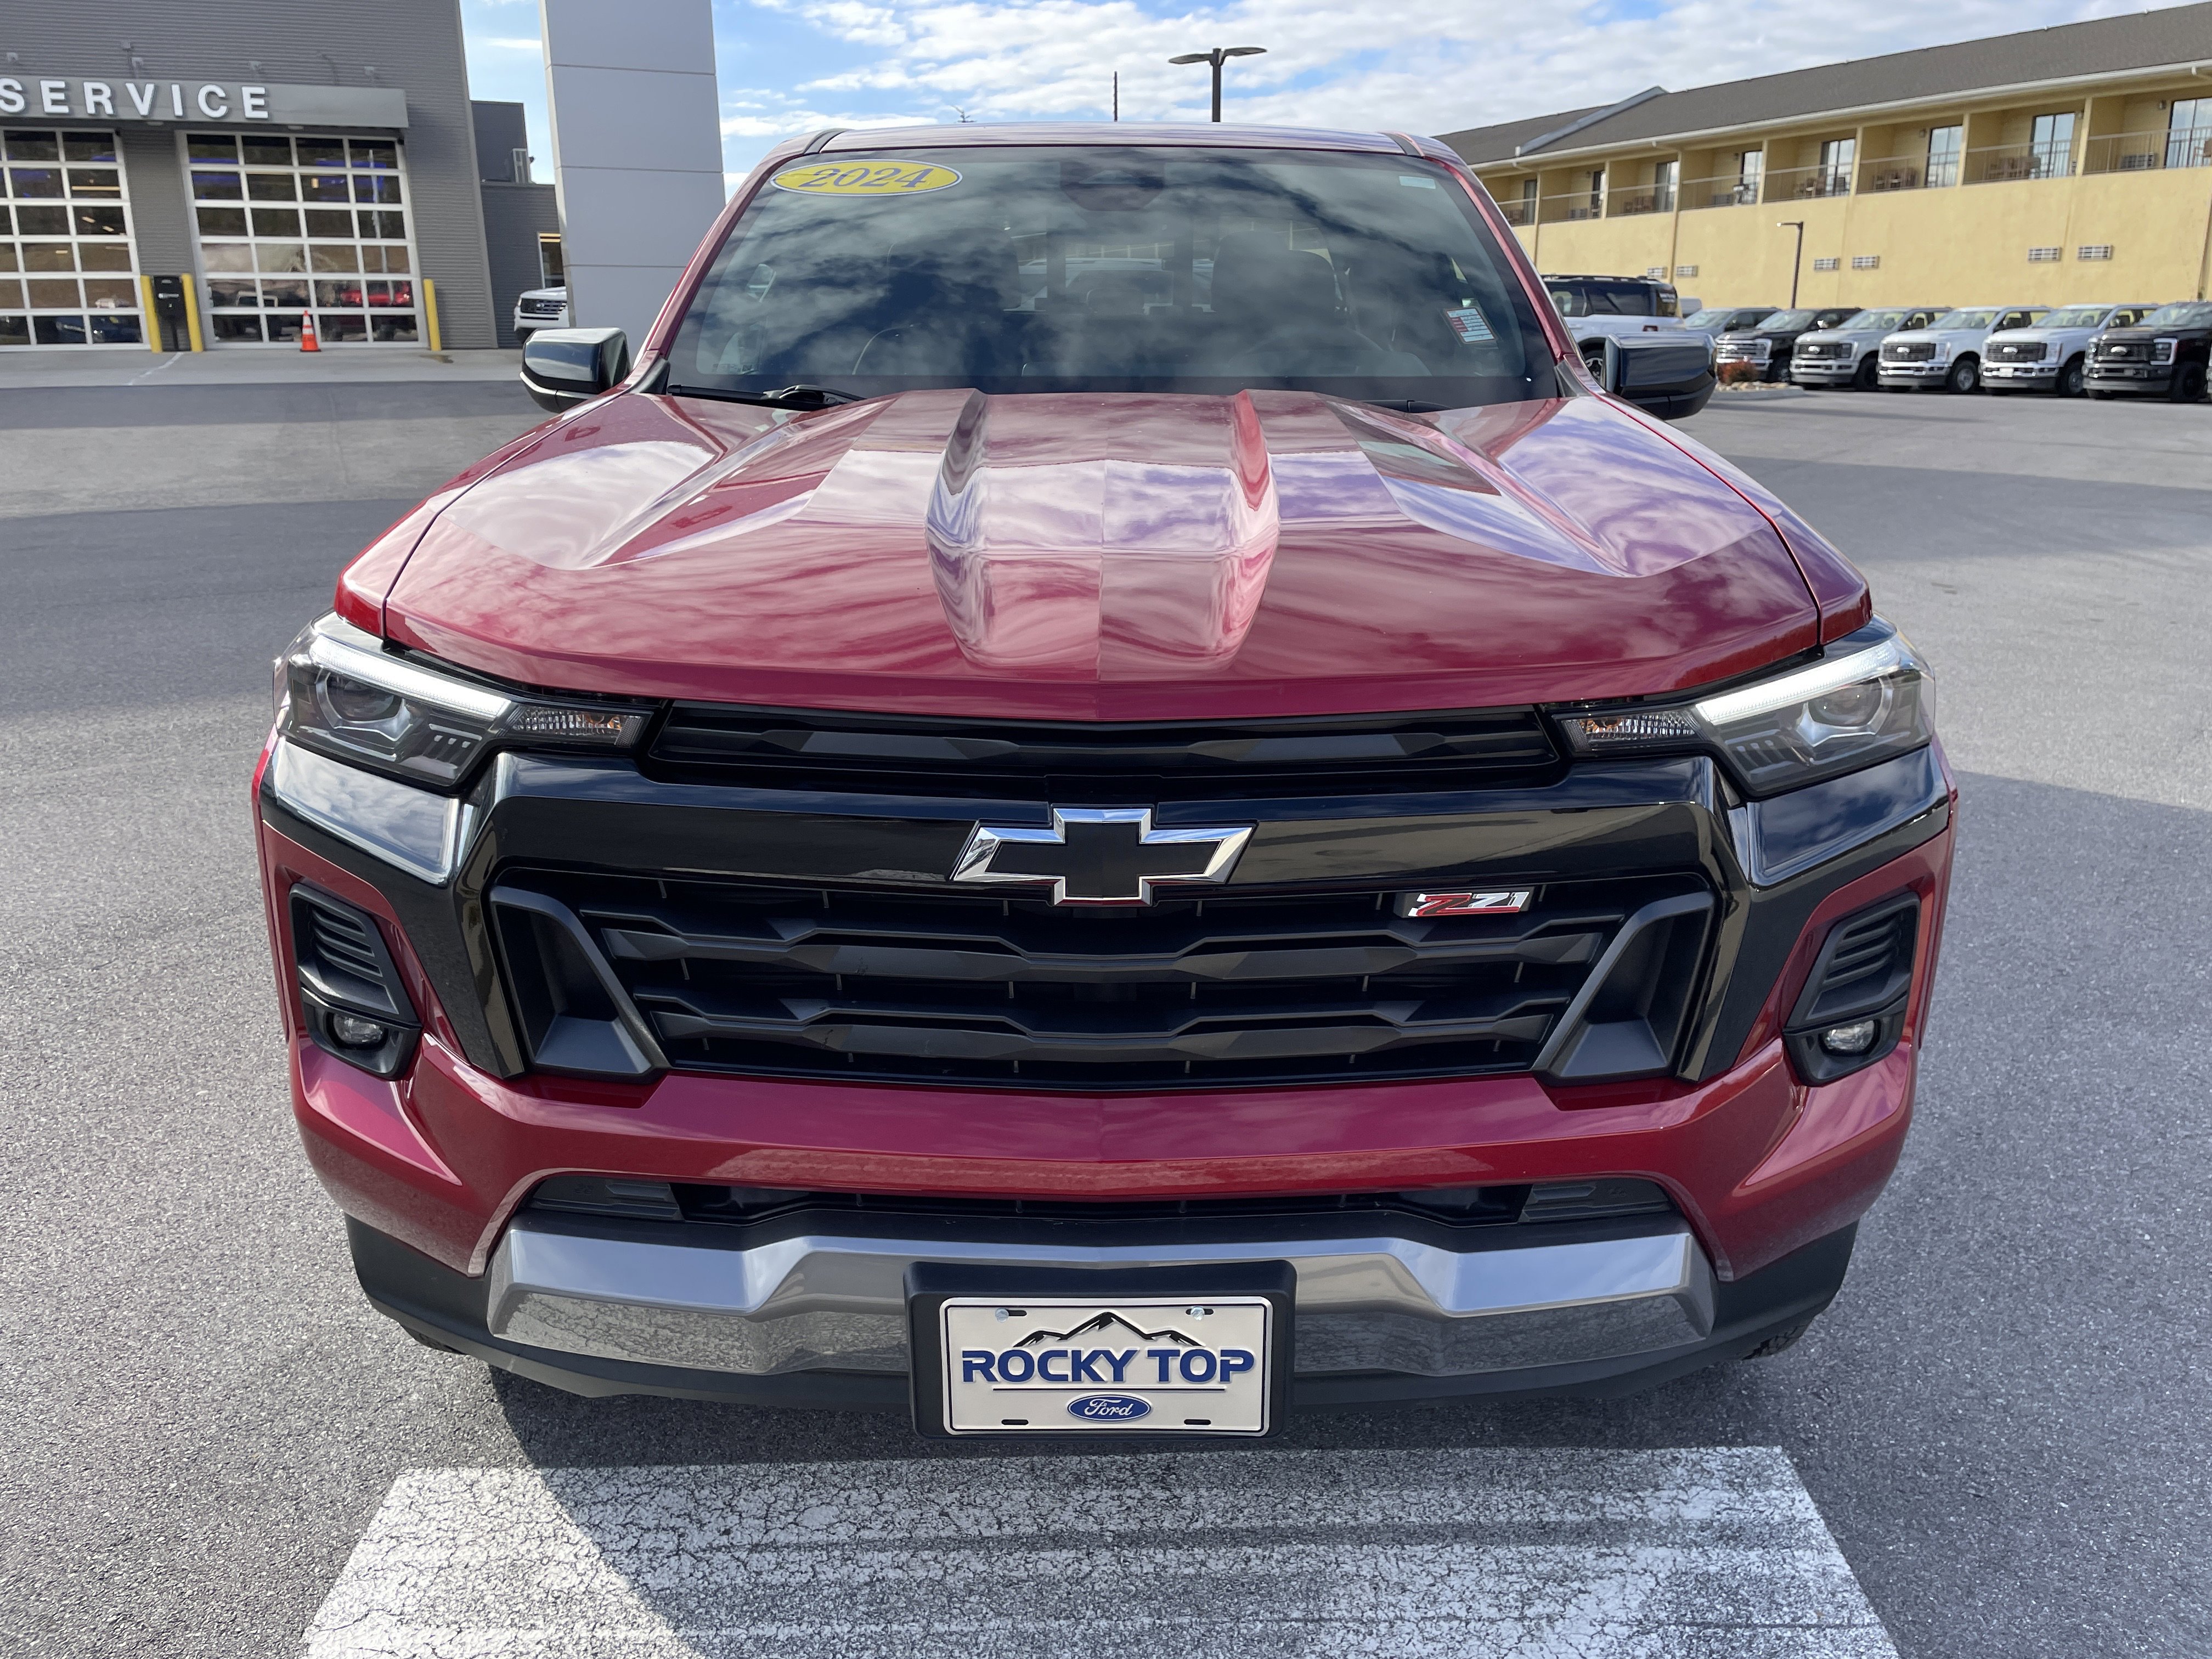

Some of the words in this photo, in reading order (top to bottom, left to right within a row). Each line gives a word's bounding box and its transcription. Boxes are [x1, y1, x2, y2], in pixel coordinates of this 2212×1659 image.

[0, 78, 269, 119] SERVICE
[798, 168, 934, 188] 2024
[1408, 892, 1530, 915] Z71
[962, 1350, 1139, 1383] ROCKY
[1148, 1350, 1255, 1383] TOP
[1084, 1398, 1135, 1416] Ford
